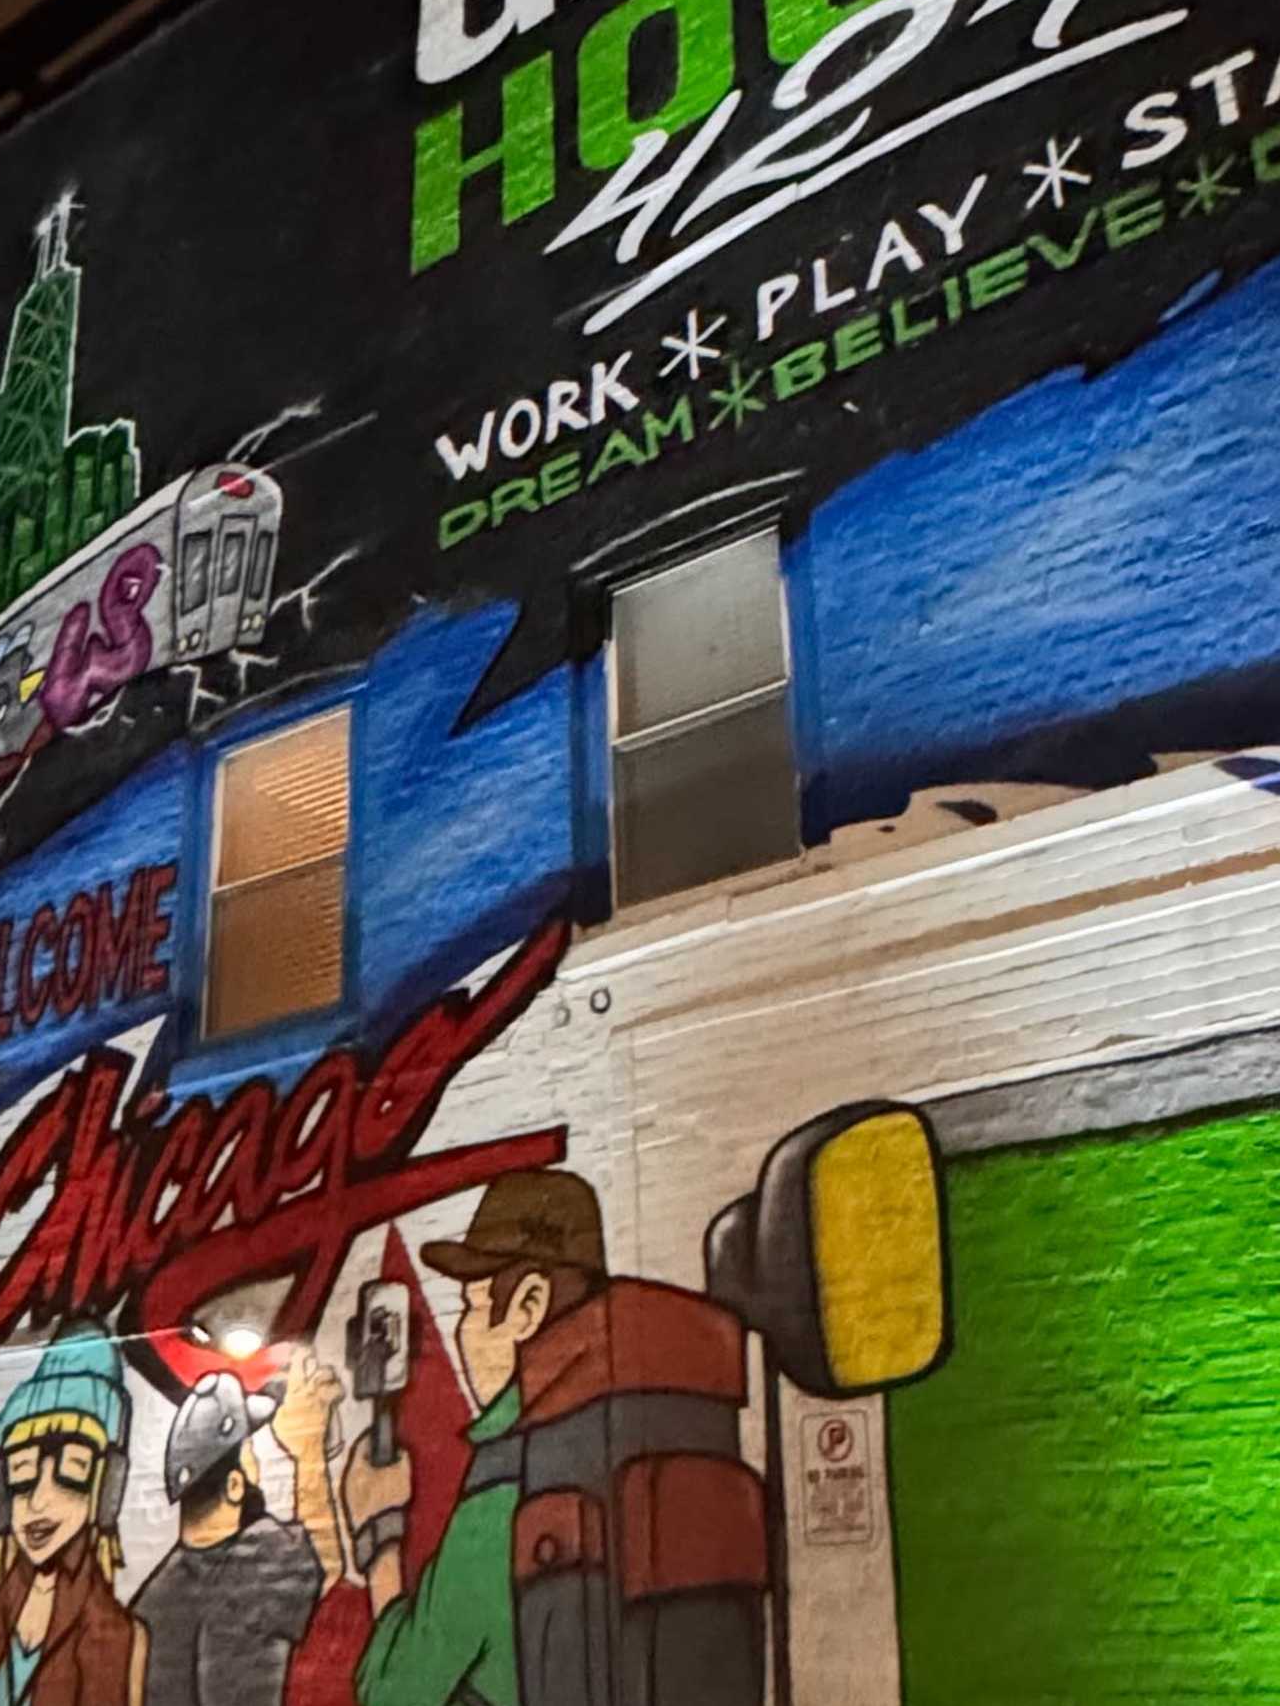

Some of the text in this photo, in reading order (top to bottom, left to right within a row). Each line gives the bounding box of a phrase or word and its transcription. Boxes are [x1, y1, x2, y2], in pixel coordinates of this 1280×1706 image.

[435, 349, 641, 481] WORK
[756, 173, 989, 341] PLAY
[437, 397, 697, 552] DREAM
[773, 180, 1167, 403] BELIEVE
